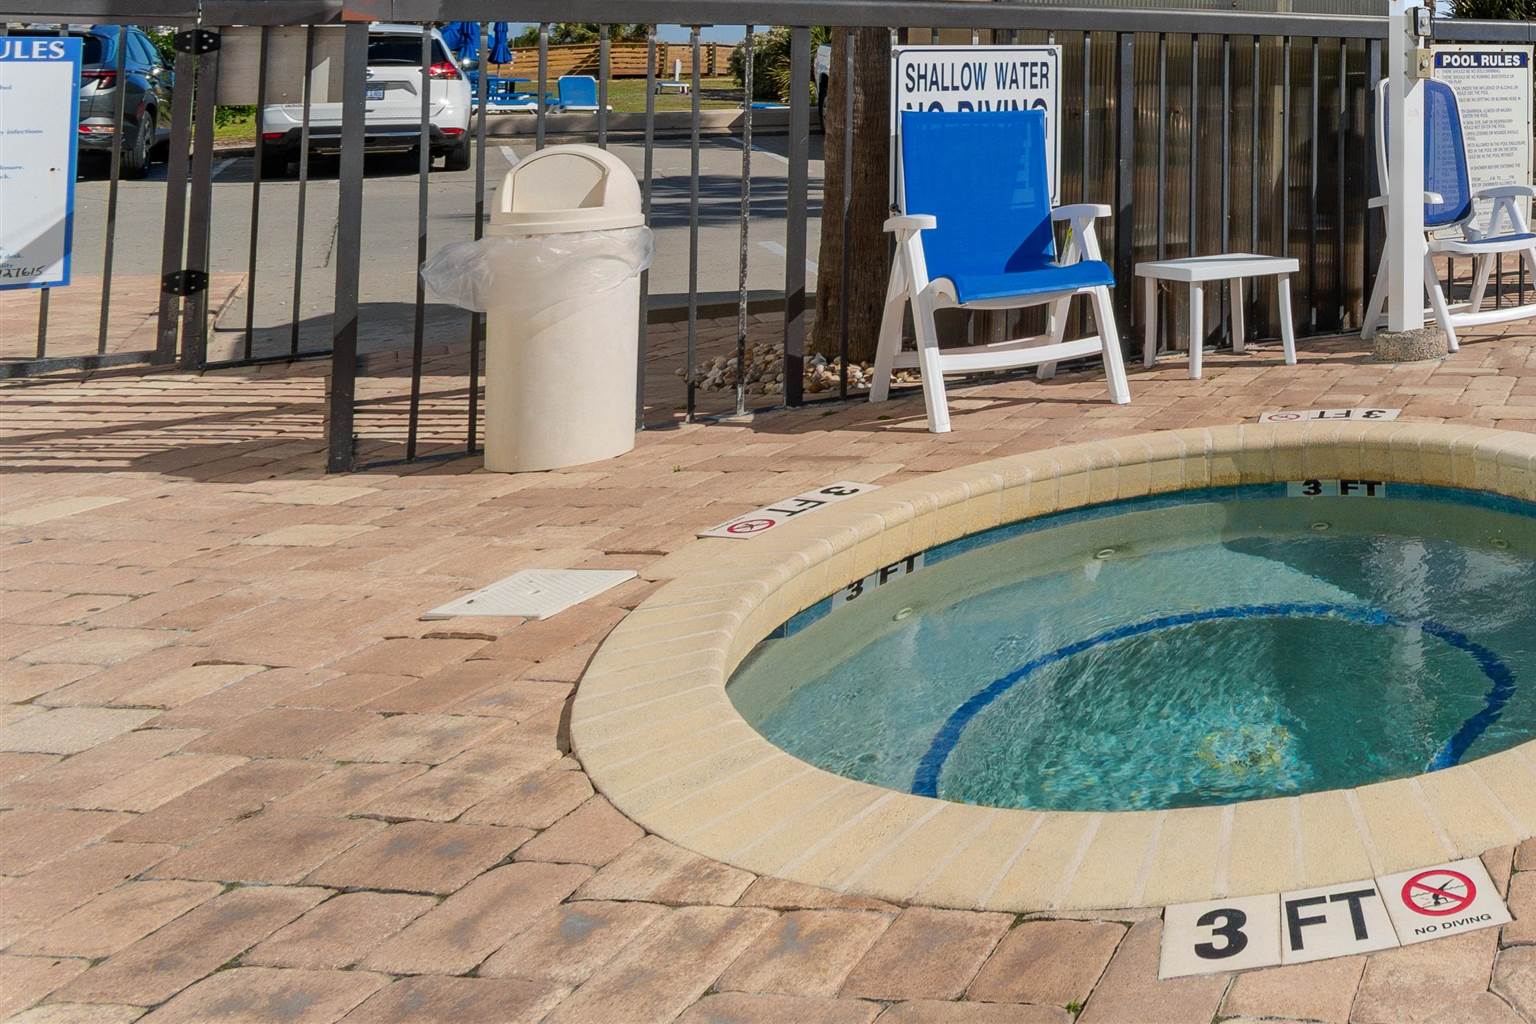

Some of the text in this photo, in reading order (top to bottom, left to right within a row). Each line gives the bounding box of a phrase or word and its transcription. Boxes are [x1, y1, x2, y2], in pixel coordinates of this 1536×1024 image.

[1442, 54, 1521, 67] POOL RULES
[905, 61, 1050, 93] SHALLOW WATER
[1311, 409, 1387, 419] 3 FT
[766, 485, 860, 517] 3 FT
[1302, 479, 1383, 497] 3 FT
[845, 551, 923, 602] 3 FT
[1194, 888, 1377, 960] 3 FT
[1415, 913, 1492, 935] NO DIVING
